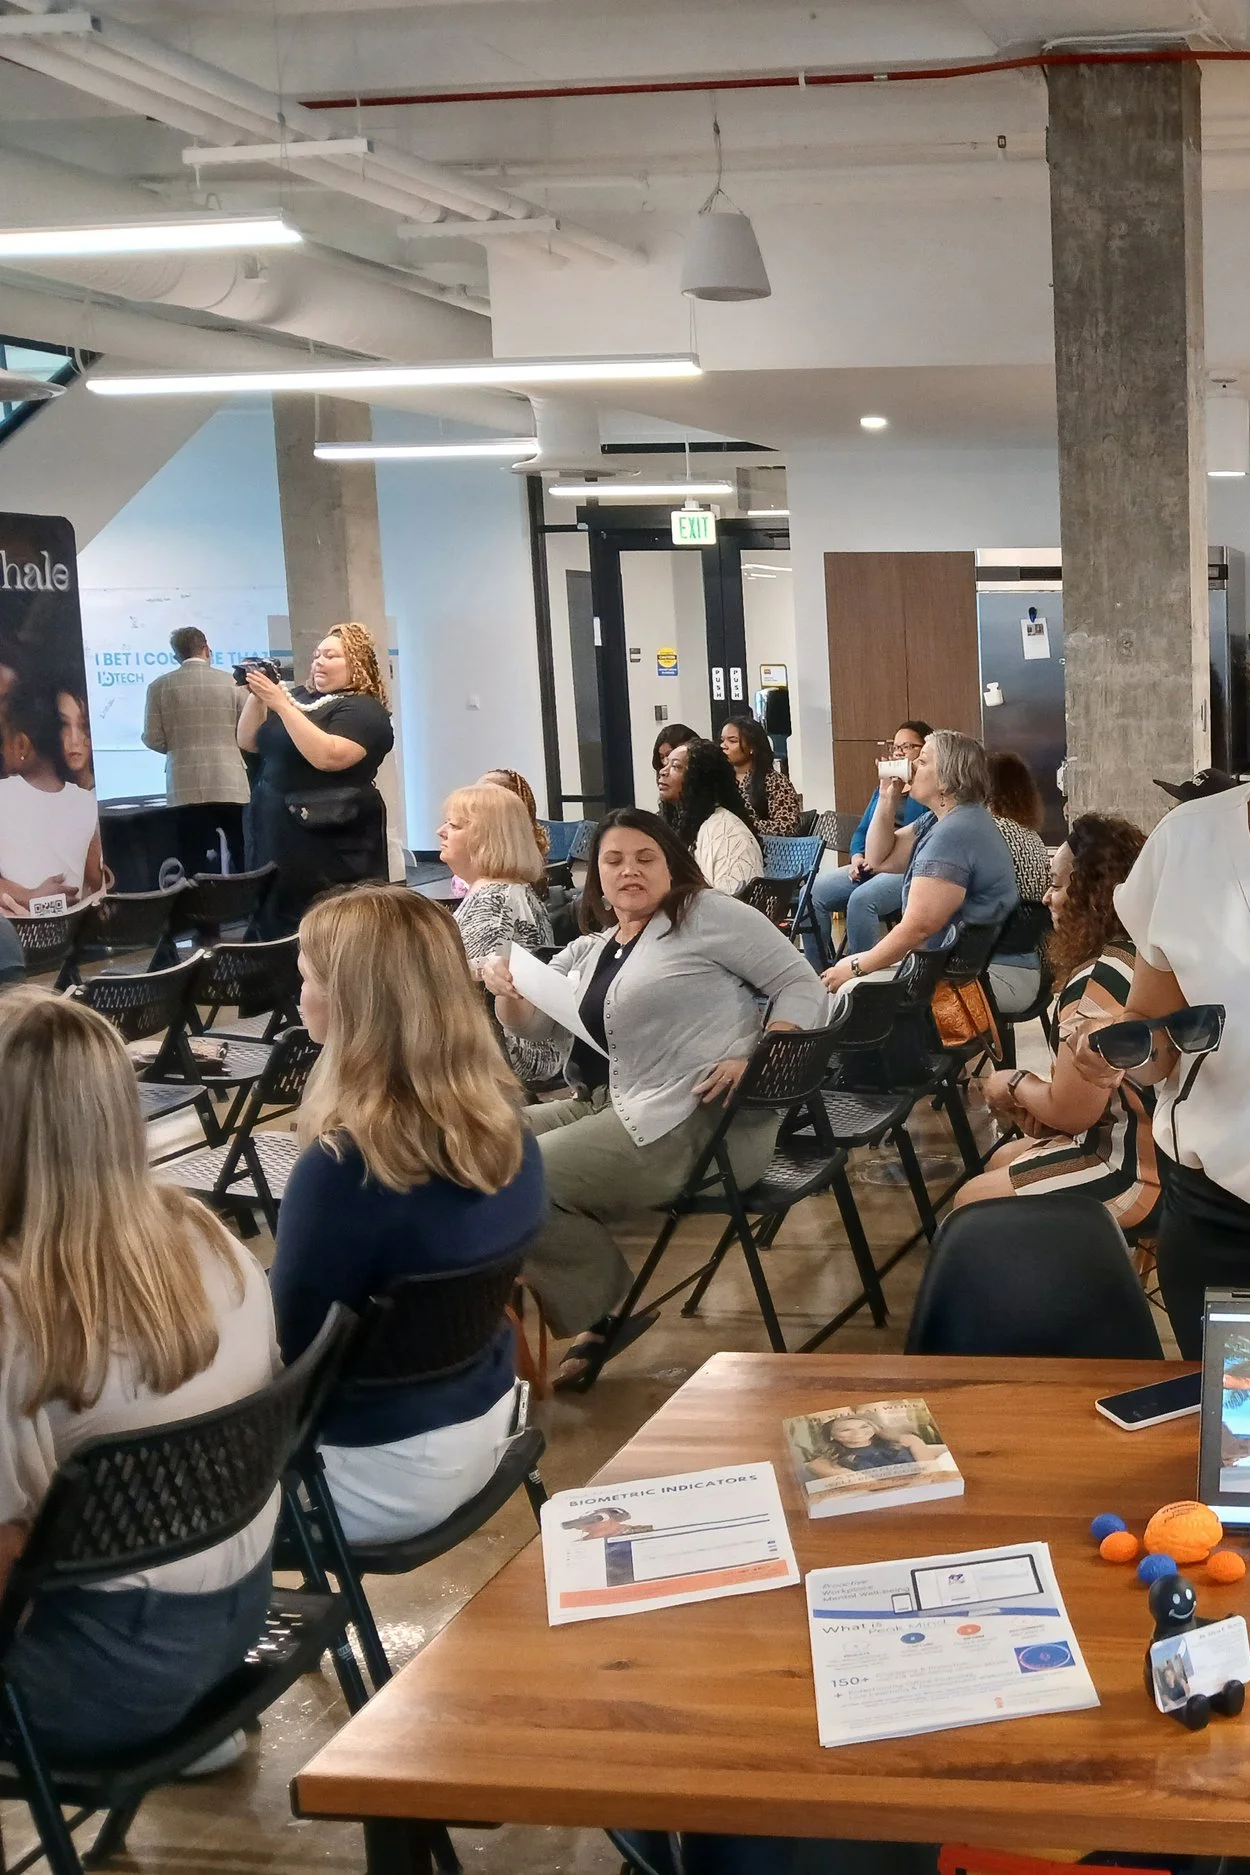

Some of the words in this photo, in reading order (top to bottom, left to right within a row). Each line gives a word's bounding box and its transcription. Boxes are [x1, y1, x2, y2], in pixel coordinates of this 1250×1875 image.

[679, 516, 709, 539] EXIT
[103, 652, 131, 666] BET
[144, 652, 178, 666] COU
[569, 1488, 656, 1507] BIOMETRIC
[661, 1474, 758, 1494] INDICATORS
[822, 1623, 865, 1634] What
[831, 1676, 869, 1688] 150+
